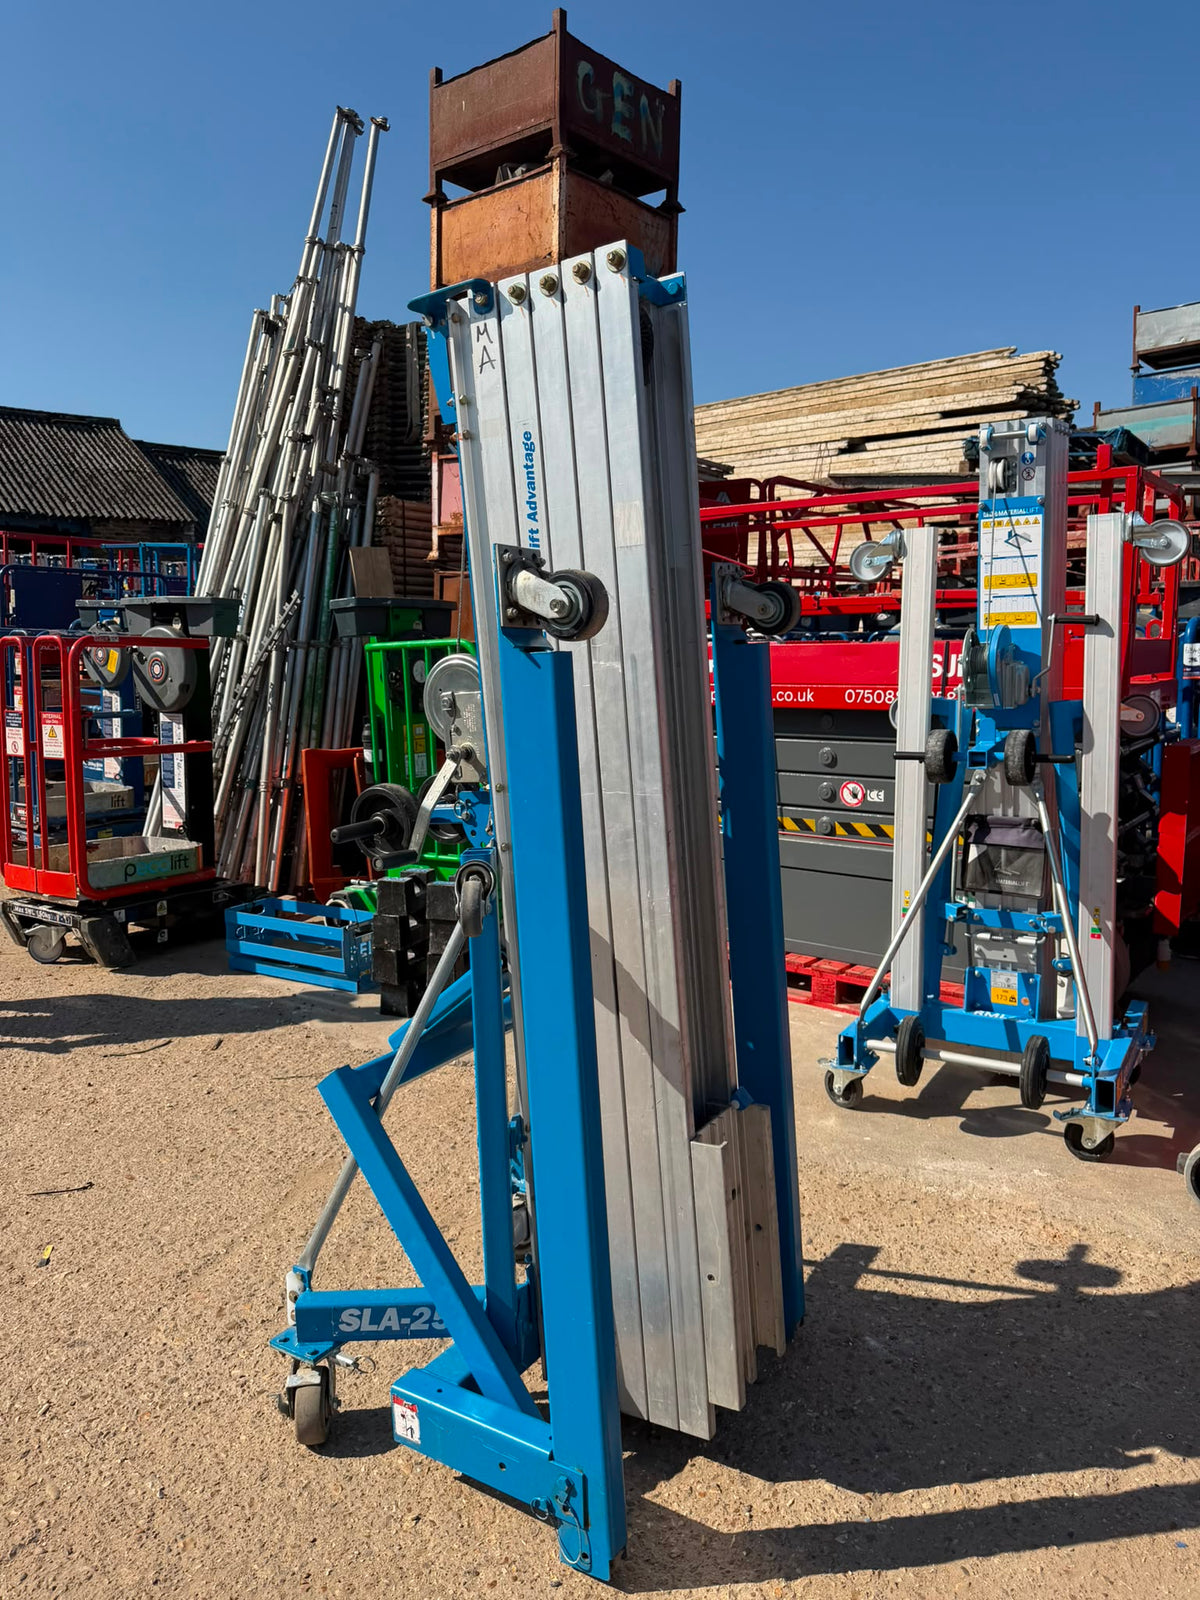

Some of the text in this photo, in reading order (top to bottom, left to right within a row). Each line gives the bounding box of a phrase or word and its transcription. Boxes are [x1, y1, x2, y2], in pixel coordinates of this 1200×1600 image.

[577, 61, 665, 160] GEN
[523, 430, 541, 549] ift Advantage
[773, 688, 815, 702] .co.uk
